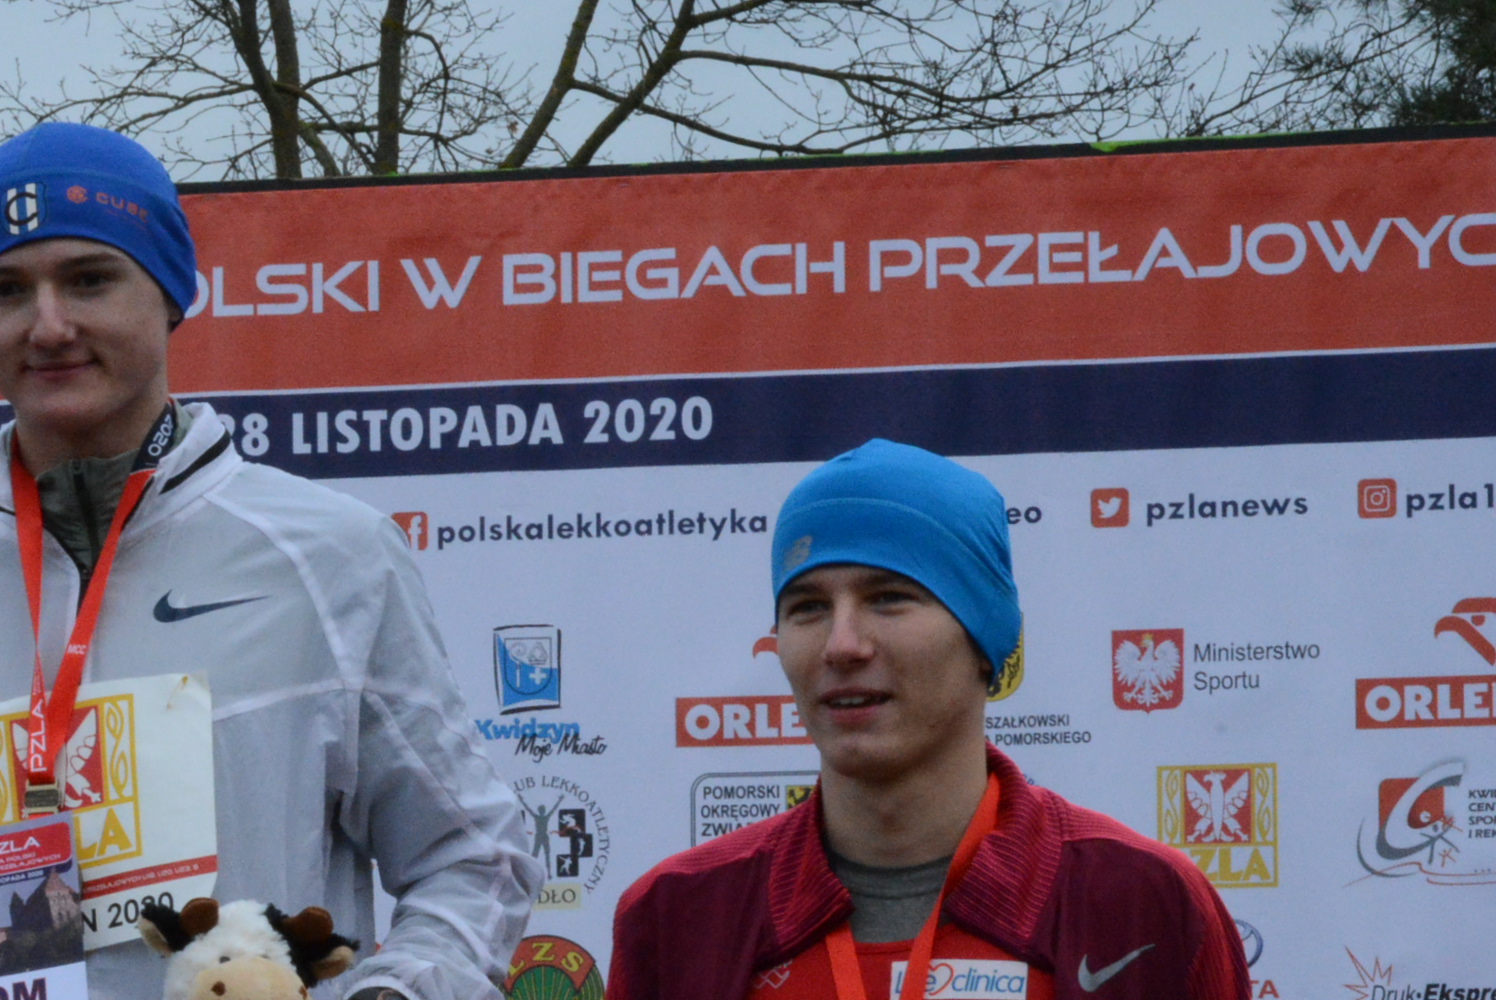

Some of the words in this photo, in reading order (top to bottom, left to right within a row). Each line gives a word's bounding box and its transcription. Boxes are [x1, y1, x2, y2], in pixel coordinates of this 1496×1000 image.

[401, 255, 482, 310] W
[503, 240, 846, 307] BIEGACH
[292, 403, 564, 454] LISTOPADA
[583, 396, 714, 444] 2020
[1146, 489, 1308, 527] pzlanews
[437, 508, 768, 551] polskalekkoatletyka
[1193, 639, 1321, 665] Ministerstwo
[1193, 670, 1261, 695] Sportu
[30, 699, 48, 773] PZLA
[474, 718, 581, 744] Kwidzyn
[994, 730, 1092, 746] POMORSKIEGO
[703, 785, 781, 800] POMORSKI
[700, 803, 781, 821] OKRĘGOWY
[950, 967, 1025, 995] clinica
